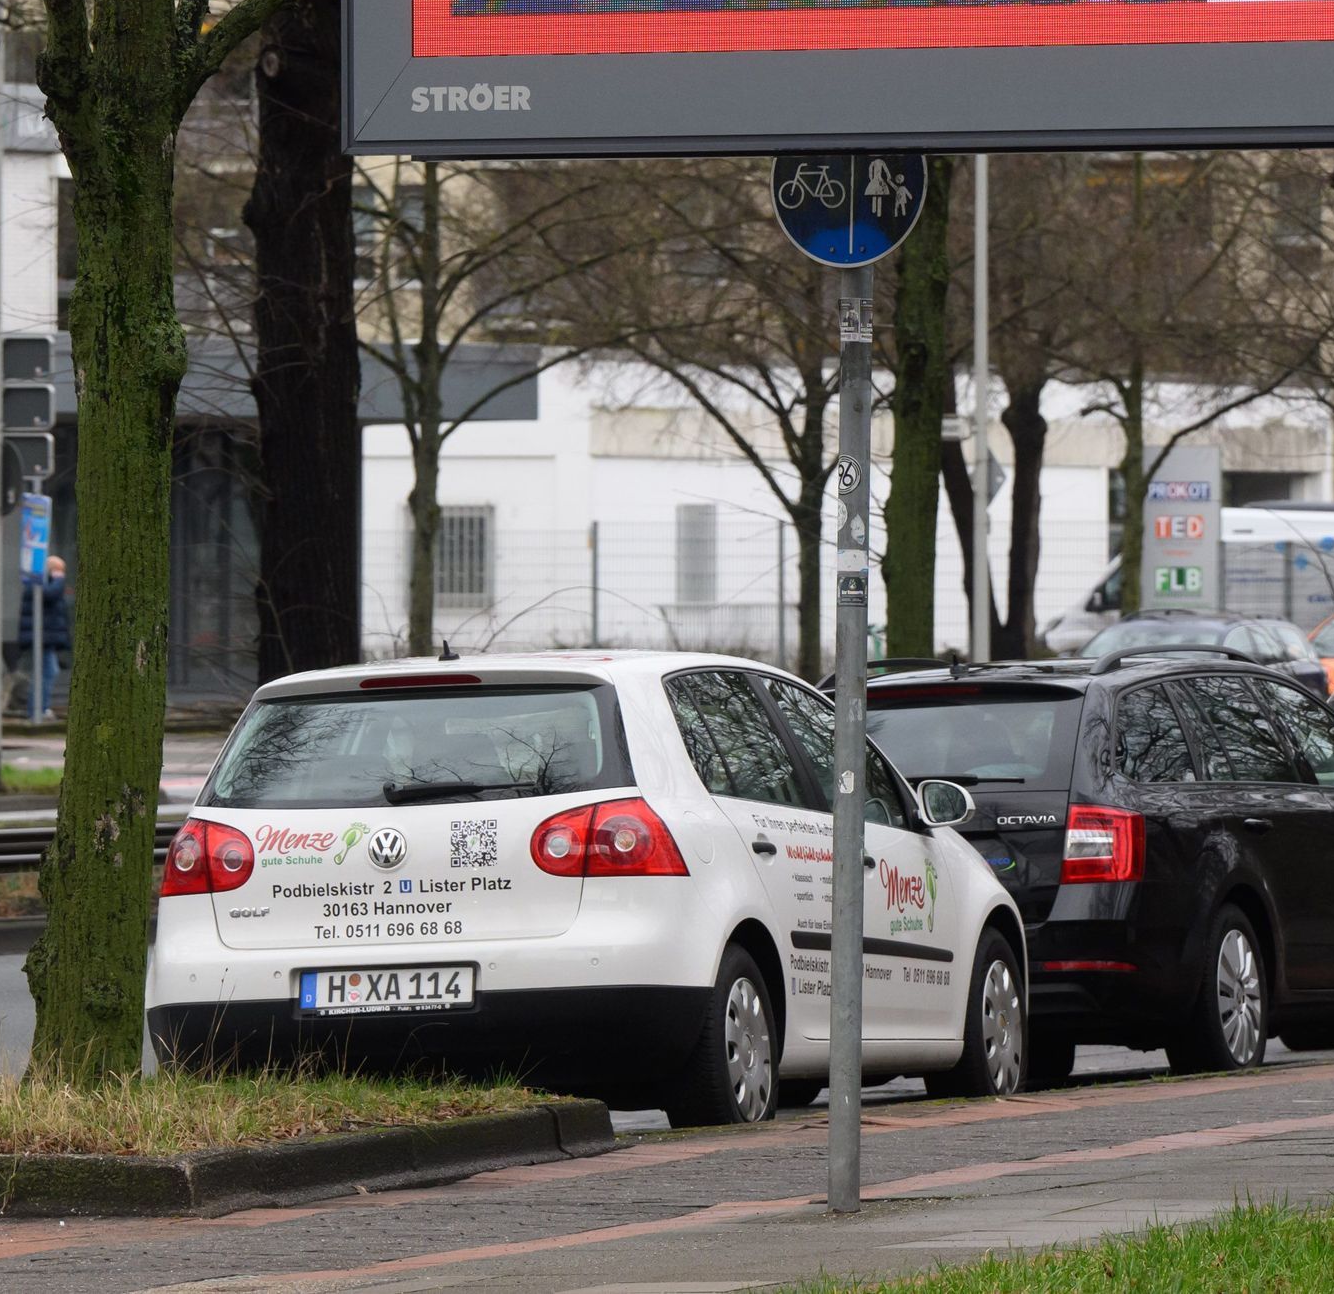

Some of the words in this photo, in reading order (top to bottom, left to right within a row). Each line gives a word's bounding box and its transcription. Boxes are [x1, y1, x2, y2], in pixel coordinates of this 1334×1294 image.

[411, 83, 532, 113] STRÖER
[1155, 515, 1204, 538] TED
[1155, 567, 1202, 592] FLB
[997, 815, 1057, 825] OCTAVIA
[255, 824, 338, 855] Menze
[261, 856, 283, 867] gute
[285, 855, 323, 866] Schuhe
[272, 883, 374, 898] Podbielskistr
[383, 881, 392, 894] 2
[419, 878, 466, 893] Lister
[471, 876, 512, 891] Platz
[880, 858, 925, 913] Menze
[229, 907, 269, 918] GOLF
[323, 903, 368, 917] 30163
[374, 901, 452, 916] Hannover
[315, 925, 340, 939] Tel.
[346, 923, 380, 938] 0511
[387, 922, 413, 937] 696
[420, 921, 438, 935] 68
[444, 920, 462, 935] 68
[865, 964, 893, 980] Hannover
[328, 975, 346, 1003] H
[365, 973, 401, 1002] XA
[408, 971, 461, 1000] 114
[798, 978, 816, 994] Lister
[305, 994, 312, 1003] D
